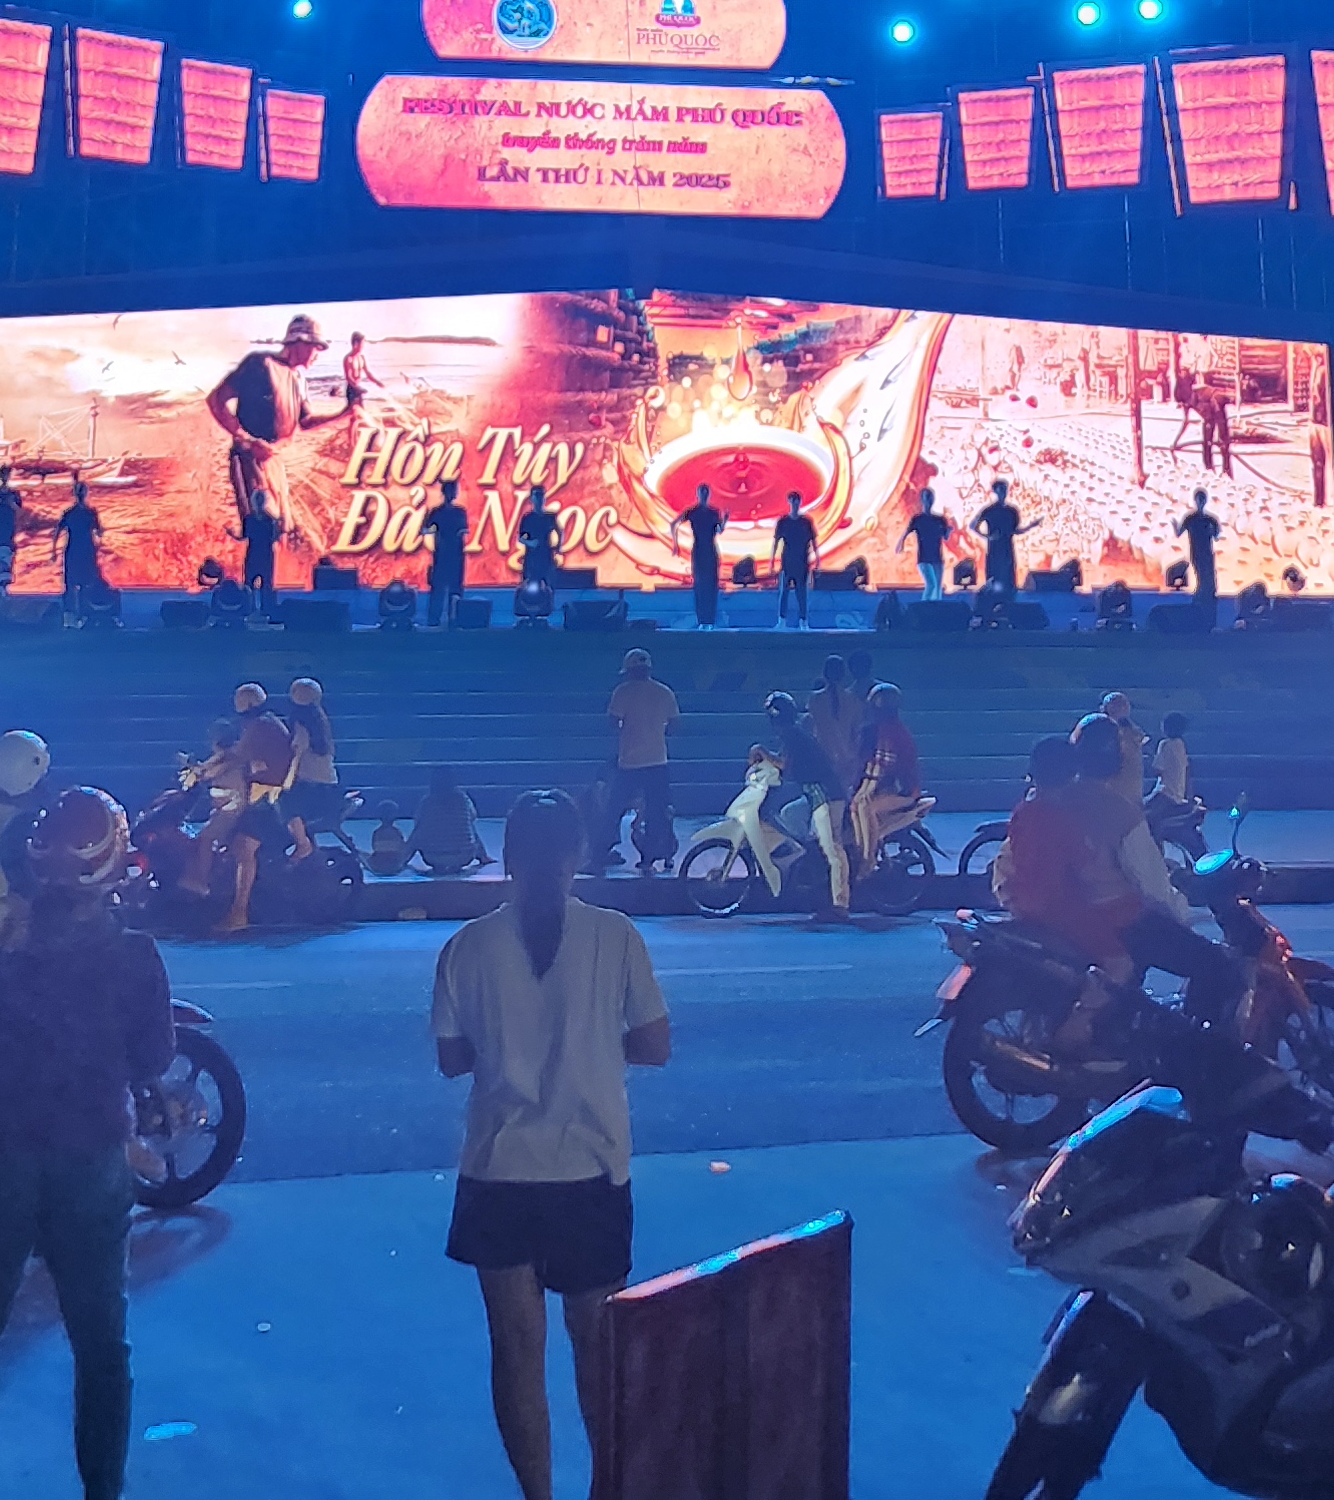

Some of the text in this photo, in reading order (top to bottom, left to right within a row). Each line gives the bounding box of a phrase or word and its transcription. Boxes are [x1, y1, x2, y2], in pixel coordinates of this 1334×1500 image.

[401, 97, 530, 117] FESTIVAL
[535, 97, 605, 119] NƯỚC
[675, 102, 727, 124] PHÚ
[672, 171, 731, 190] 2025
[339, 417, 585, 499] Hồn Túy
